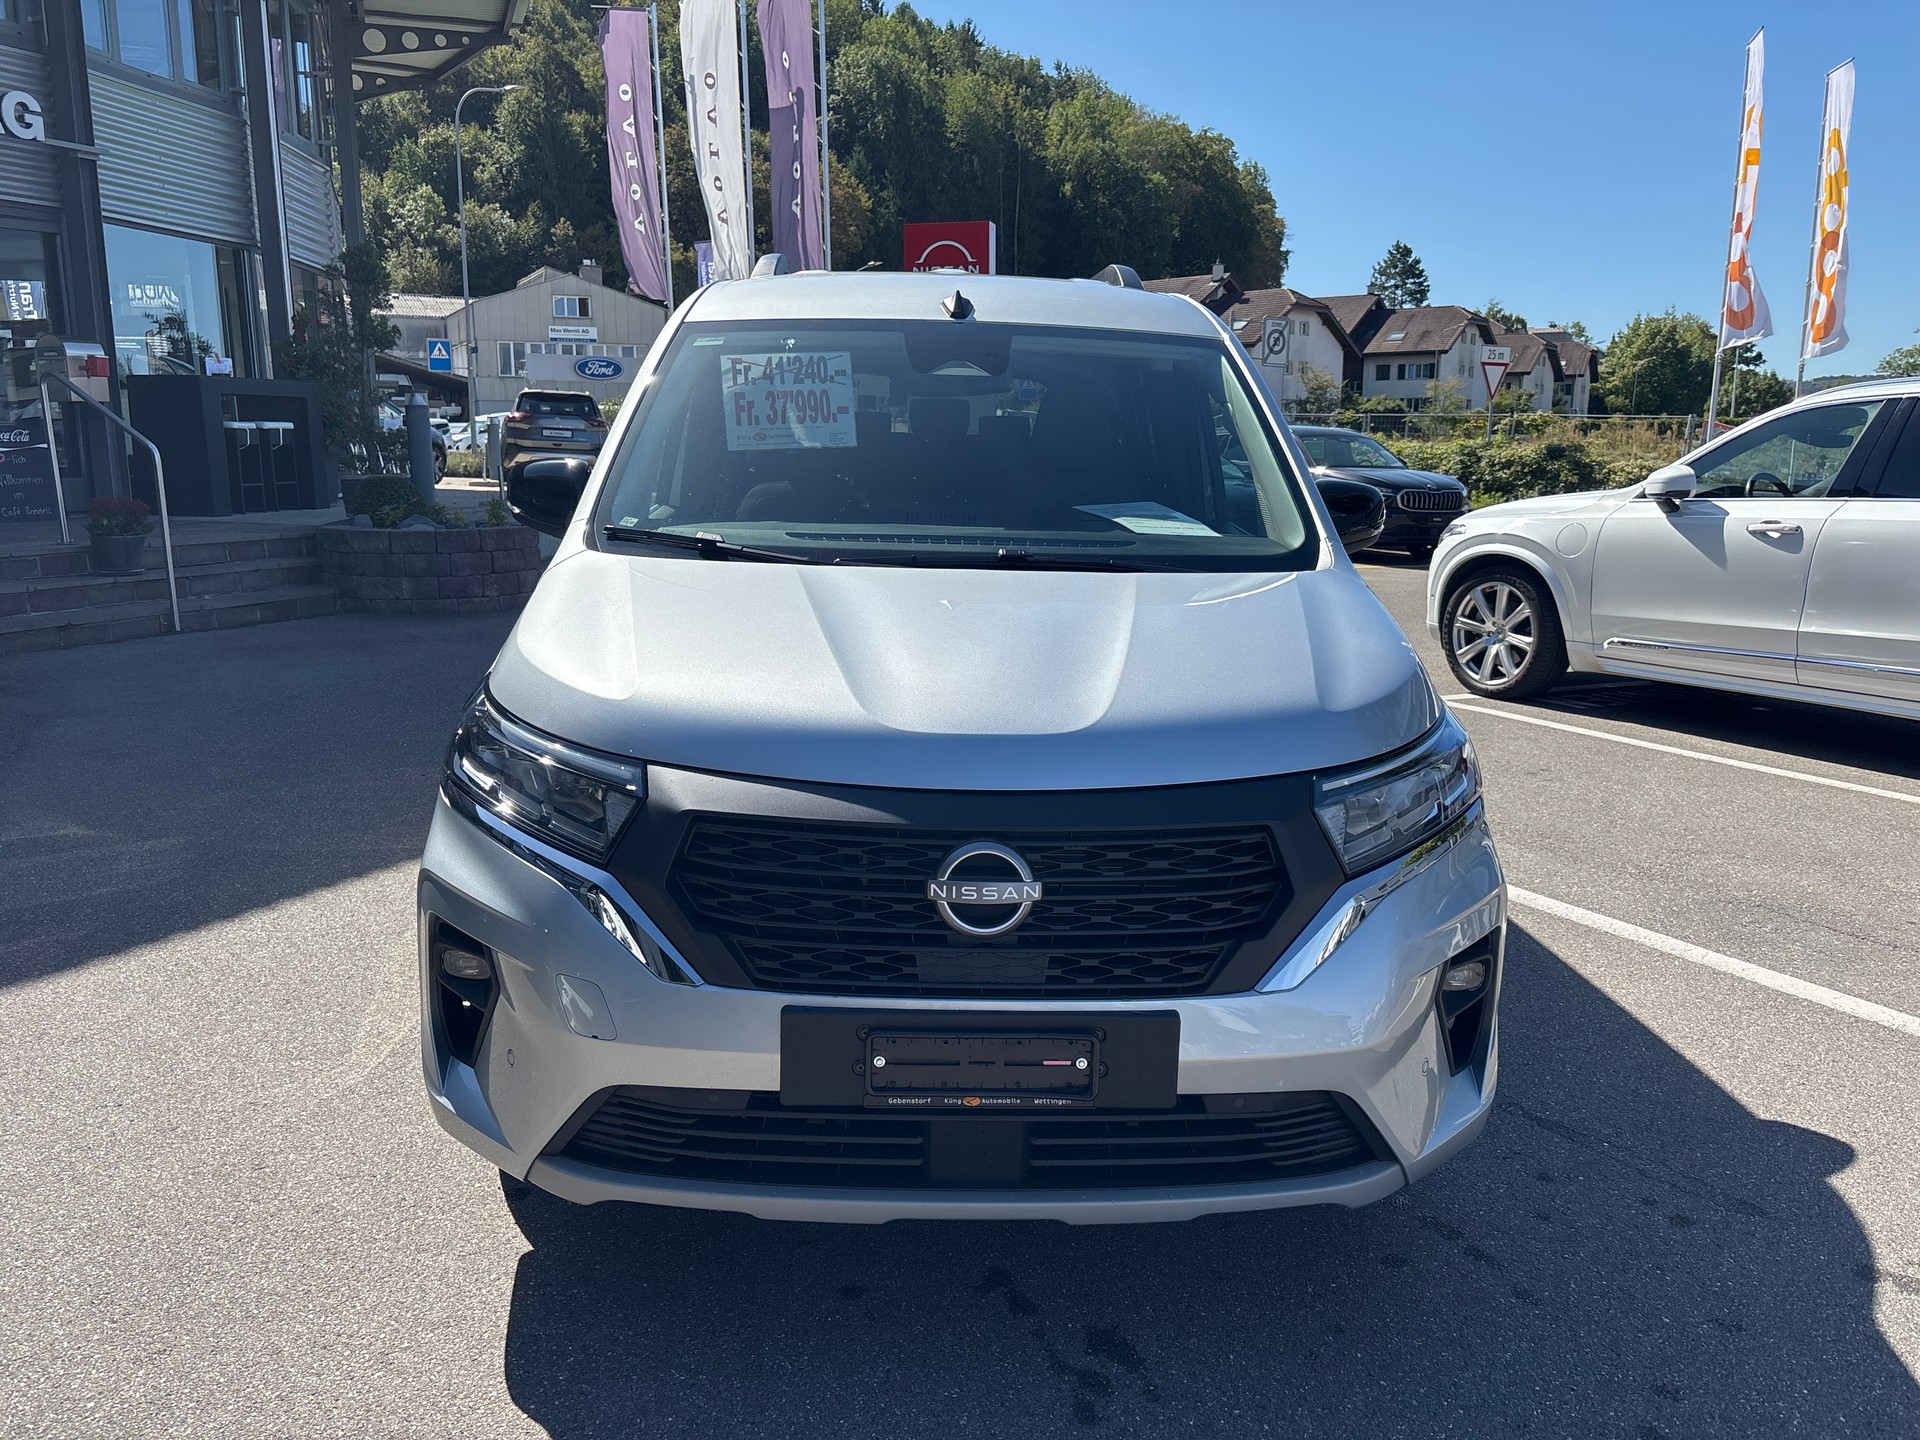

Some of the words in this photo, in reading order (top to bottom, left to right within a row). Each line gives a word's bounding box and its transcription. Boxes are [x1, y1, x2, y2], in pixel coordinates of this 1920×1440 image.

[0, 90, 46, 142] G
[1488, 349, 1496, 360] 25
[1498, 352, 1504, 360] m
[585, 361, 615, 375] Ford
[731, 357, 757, 386] Fr.
[734, 391, 760, 426] Fr.
[930, 883, 1040, 900] NISSAN
[944, 1096, 962, 1105] Küng
[1034, 1097, 1072, 1106] Wettingen
